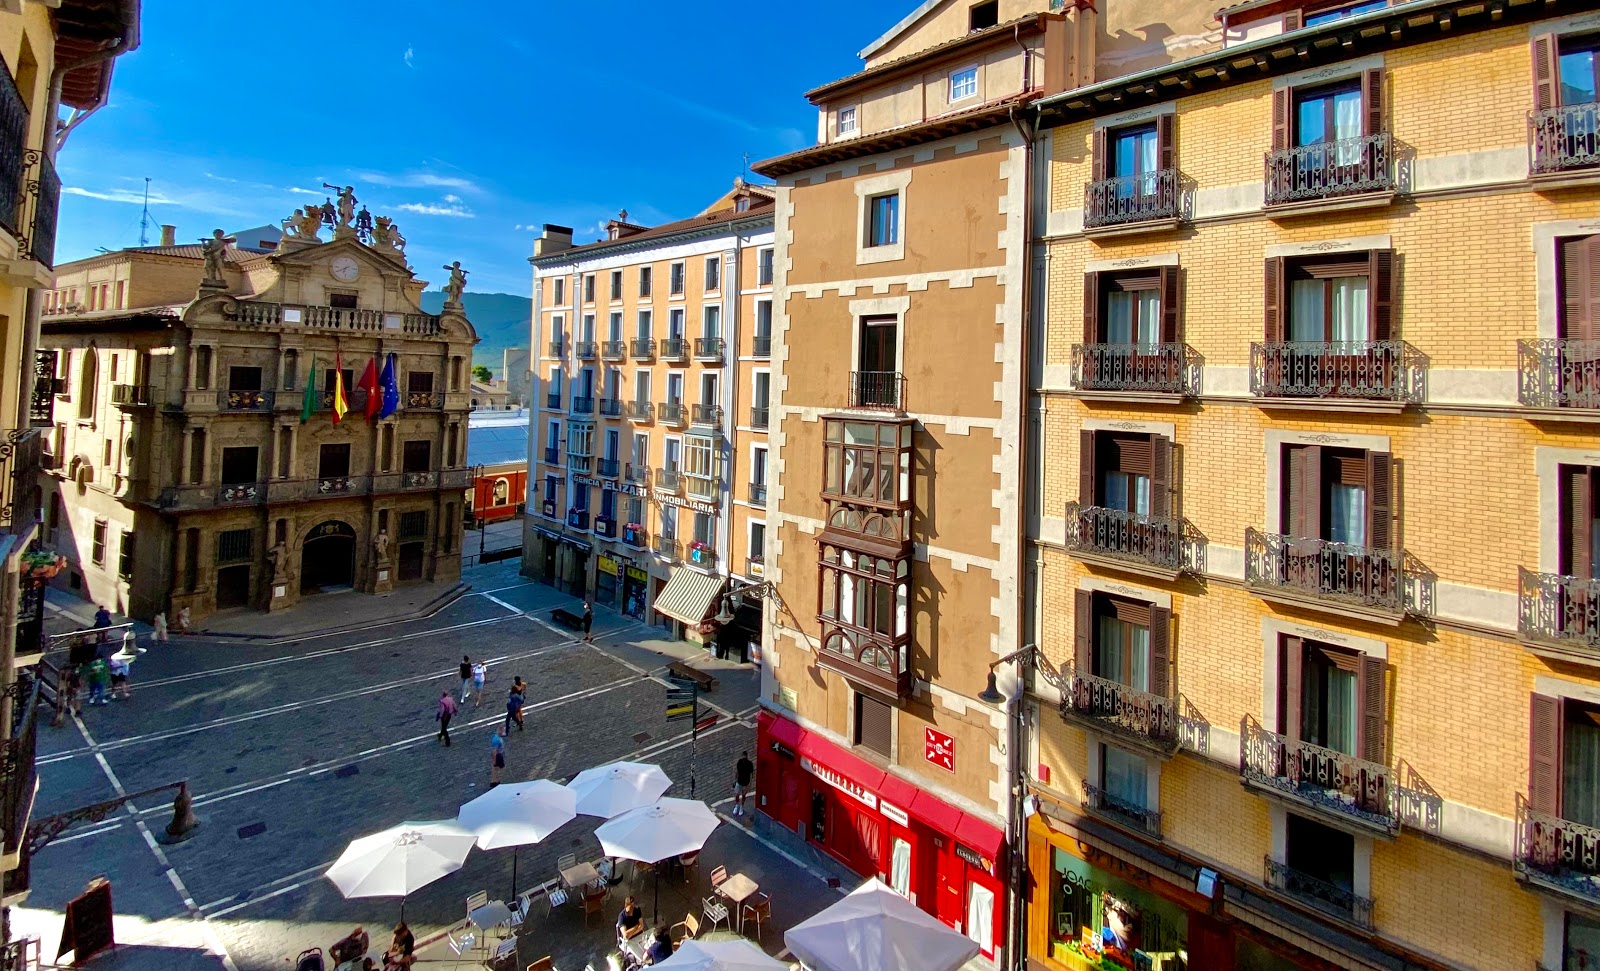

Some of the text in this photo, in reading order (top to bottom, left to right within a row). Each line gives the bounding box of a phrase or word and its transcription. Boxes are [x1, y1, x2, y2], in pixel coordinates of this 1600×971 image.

[603, 480, 647, 497] ELIZARI
[653, 492, 715, 513] INMOBILIARIA
[811, 762, 865, 800] GUTIERREZ
